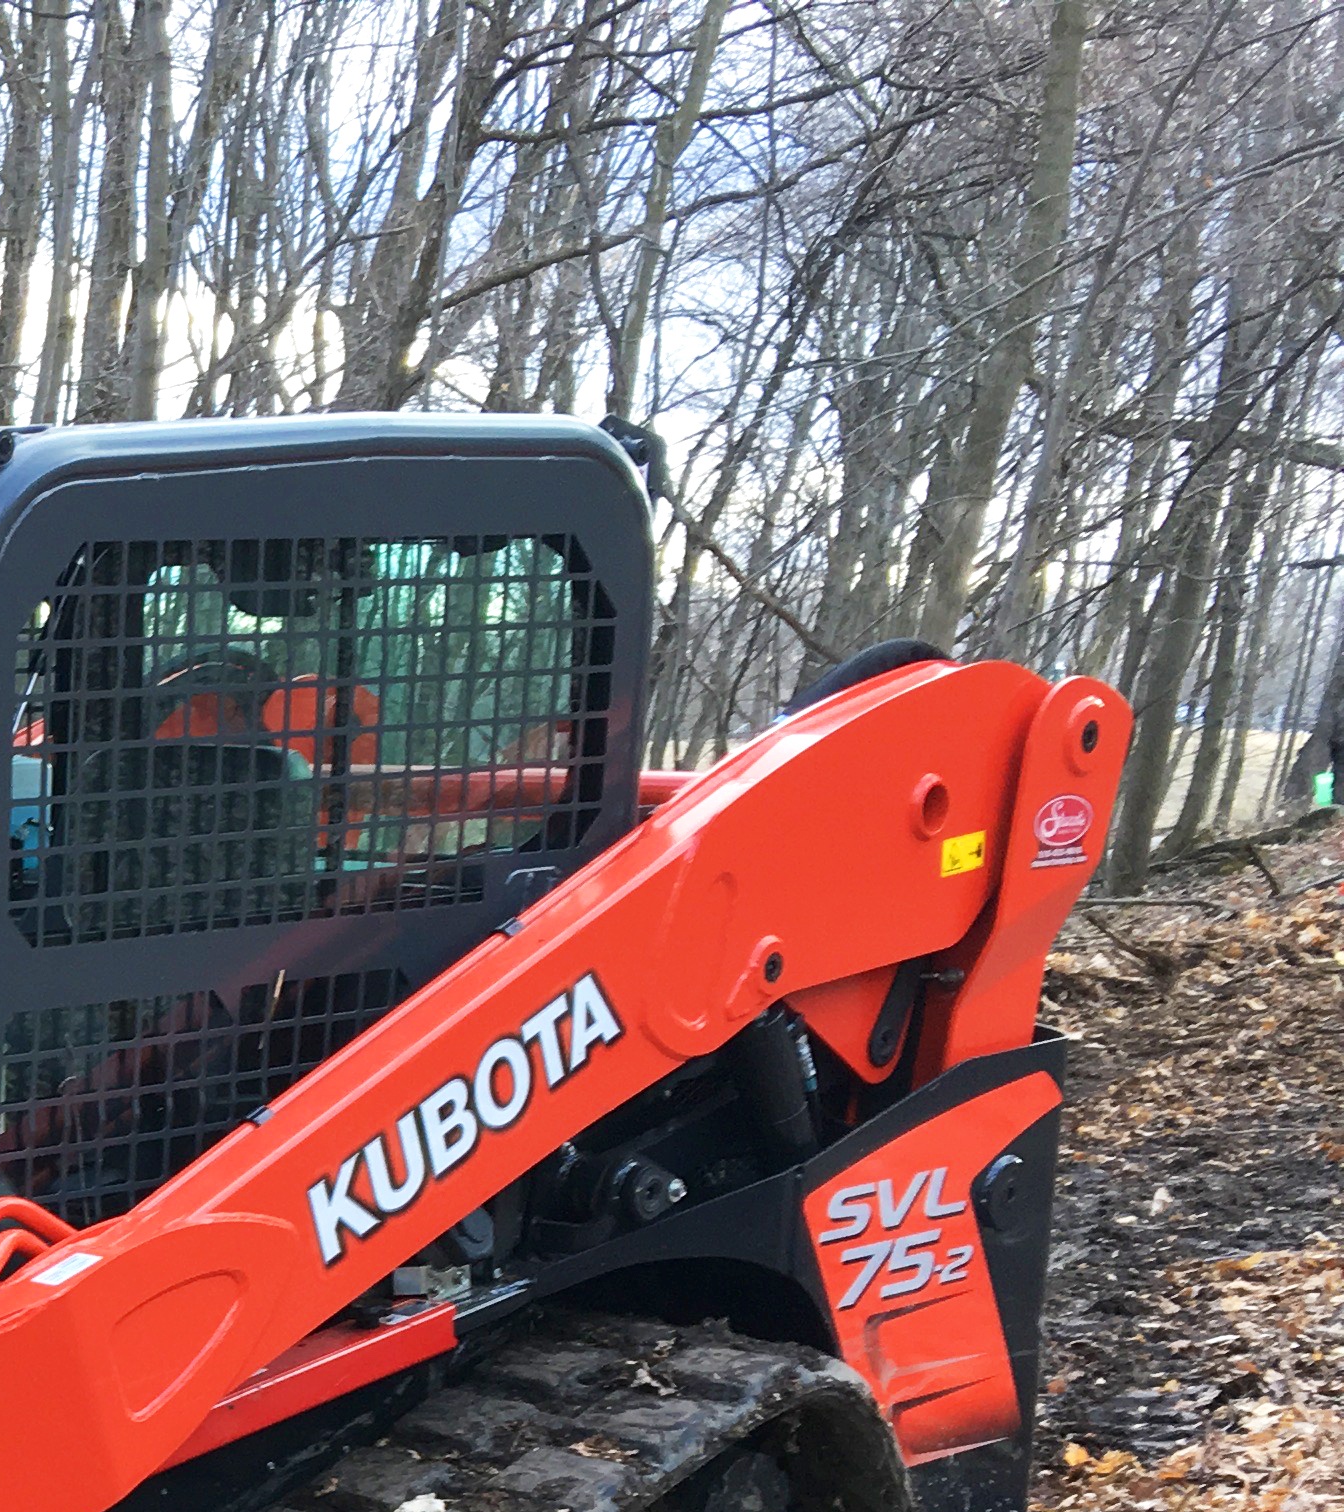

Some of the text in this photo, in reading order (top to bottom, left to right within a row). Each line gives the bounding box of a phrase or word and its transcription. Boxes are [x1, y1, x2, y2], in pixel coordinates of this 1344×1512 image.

[306, 971, 623, 1267] KUBOTA
[818, 1166, 968, 1245] SVL
[837, 1228, 974, 1311] 75-2
